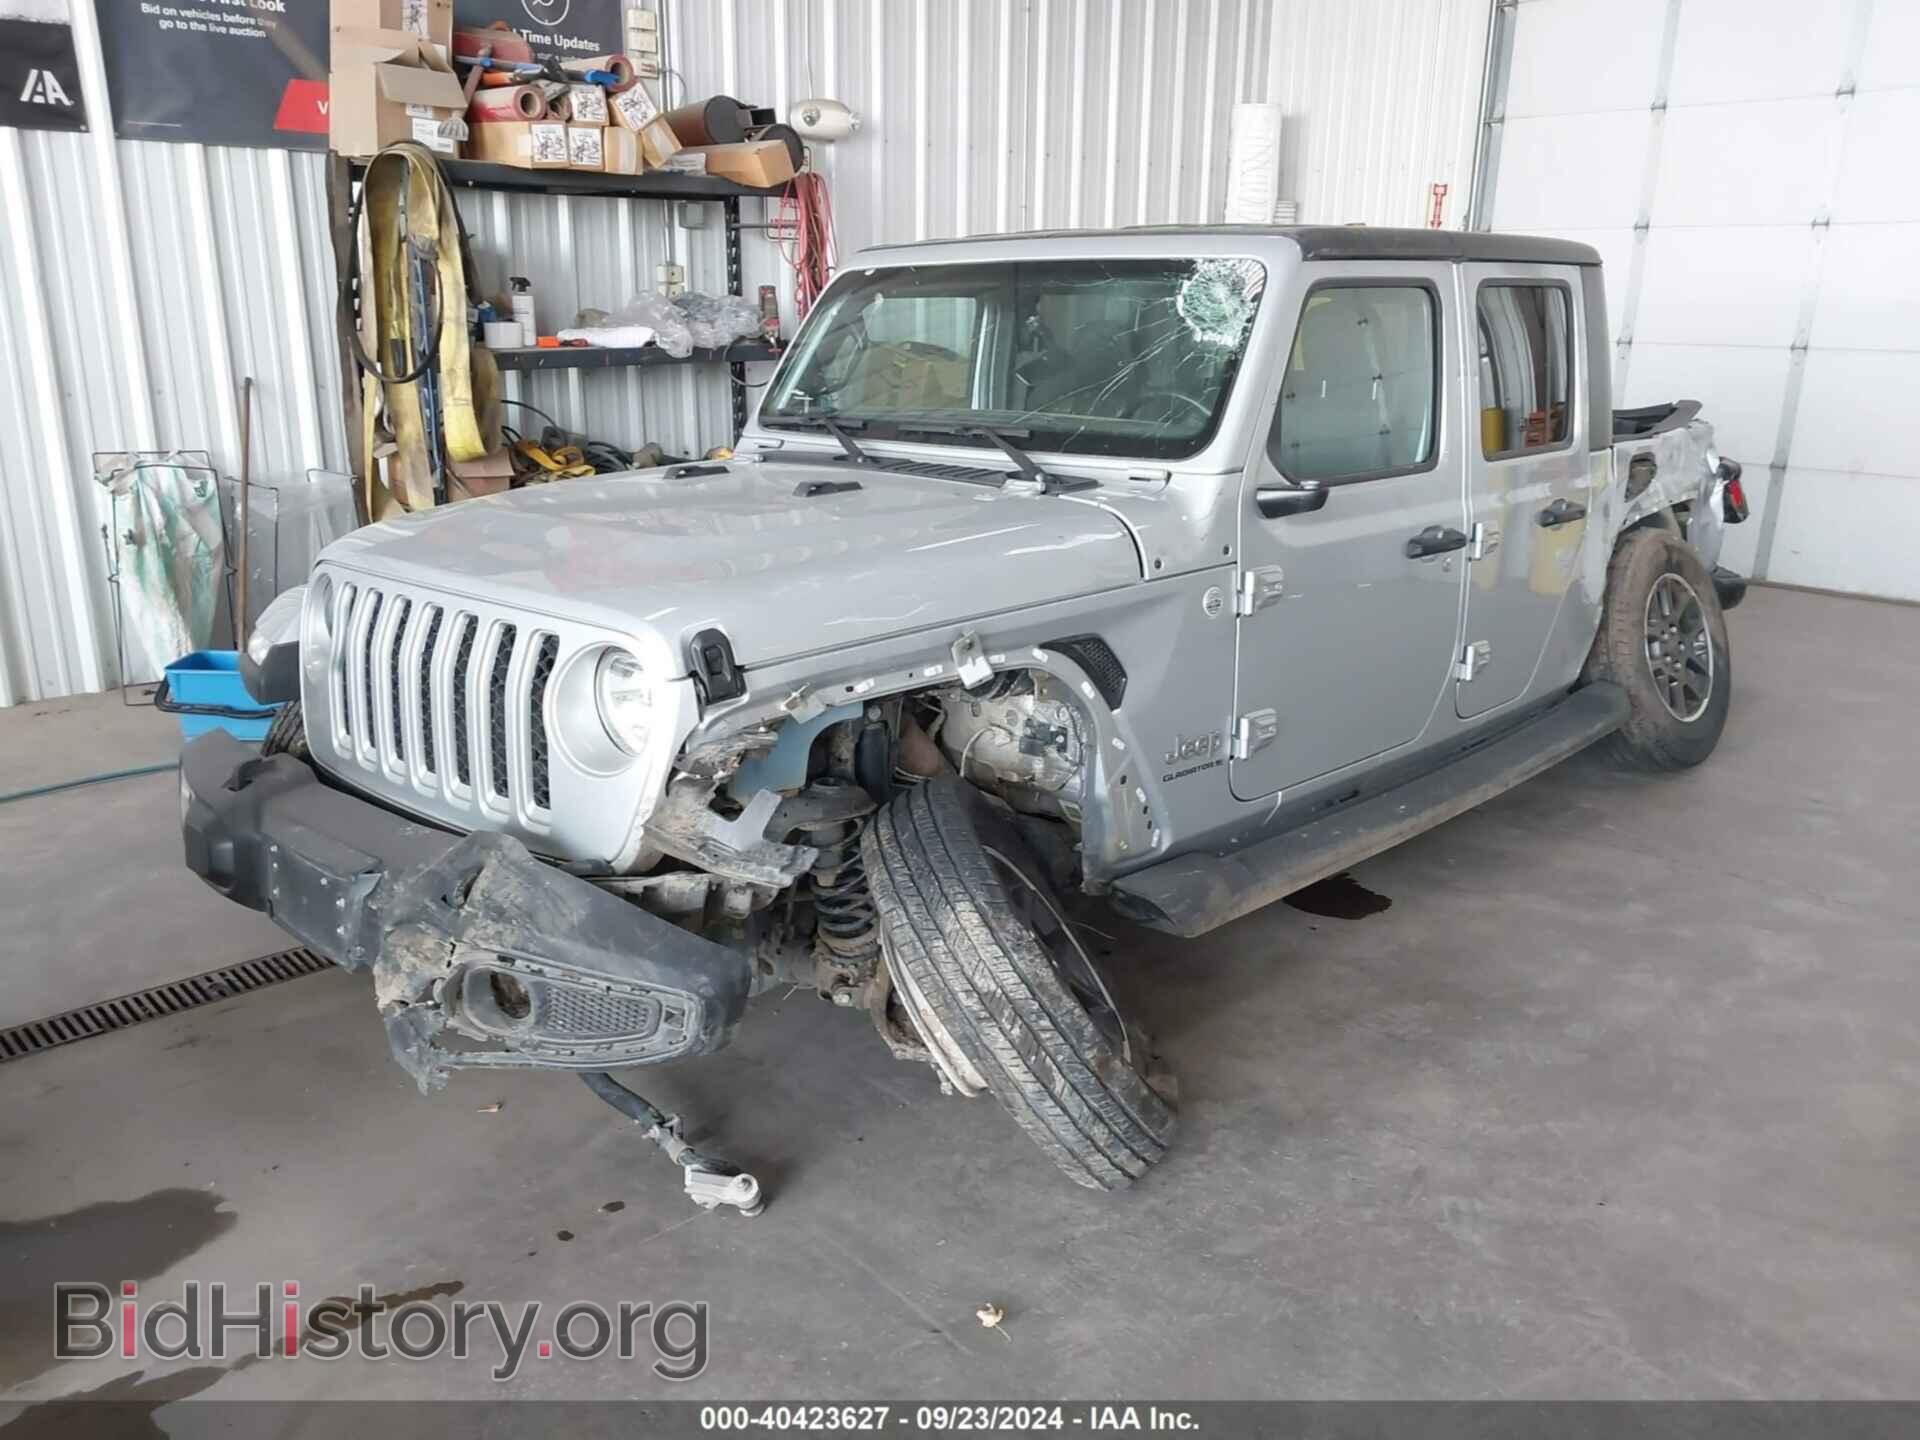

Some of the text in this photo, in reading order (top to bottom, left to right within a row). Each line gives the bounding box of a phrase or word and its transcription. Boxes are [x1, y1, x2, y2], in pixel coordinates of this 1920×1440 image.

[141, 3, 160, 15] Bid
[163, 8, 177, 17] on
[179, 9, 221, 22] vehicles
[222, 12, 256, 25] before
[159, 19, 266, 38] go to the live auction
[520, 28, 601, 52] Time Updates
[1165, 730, 1221, 765] Jeep
